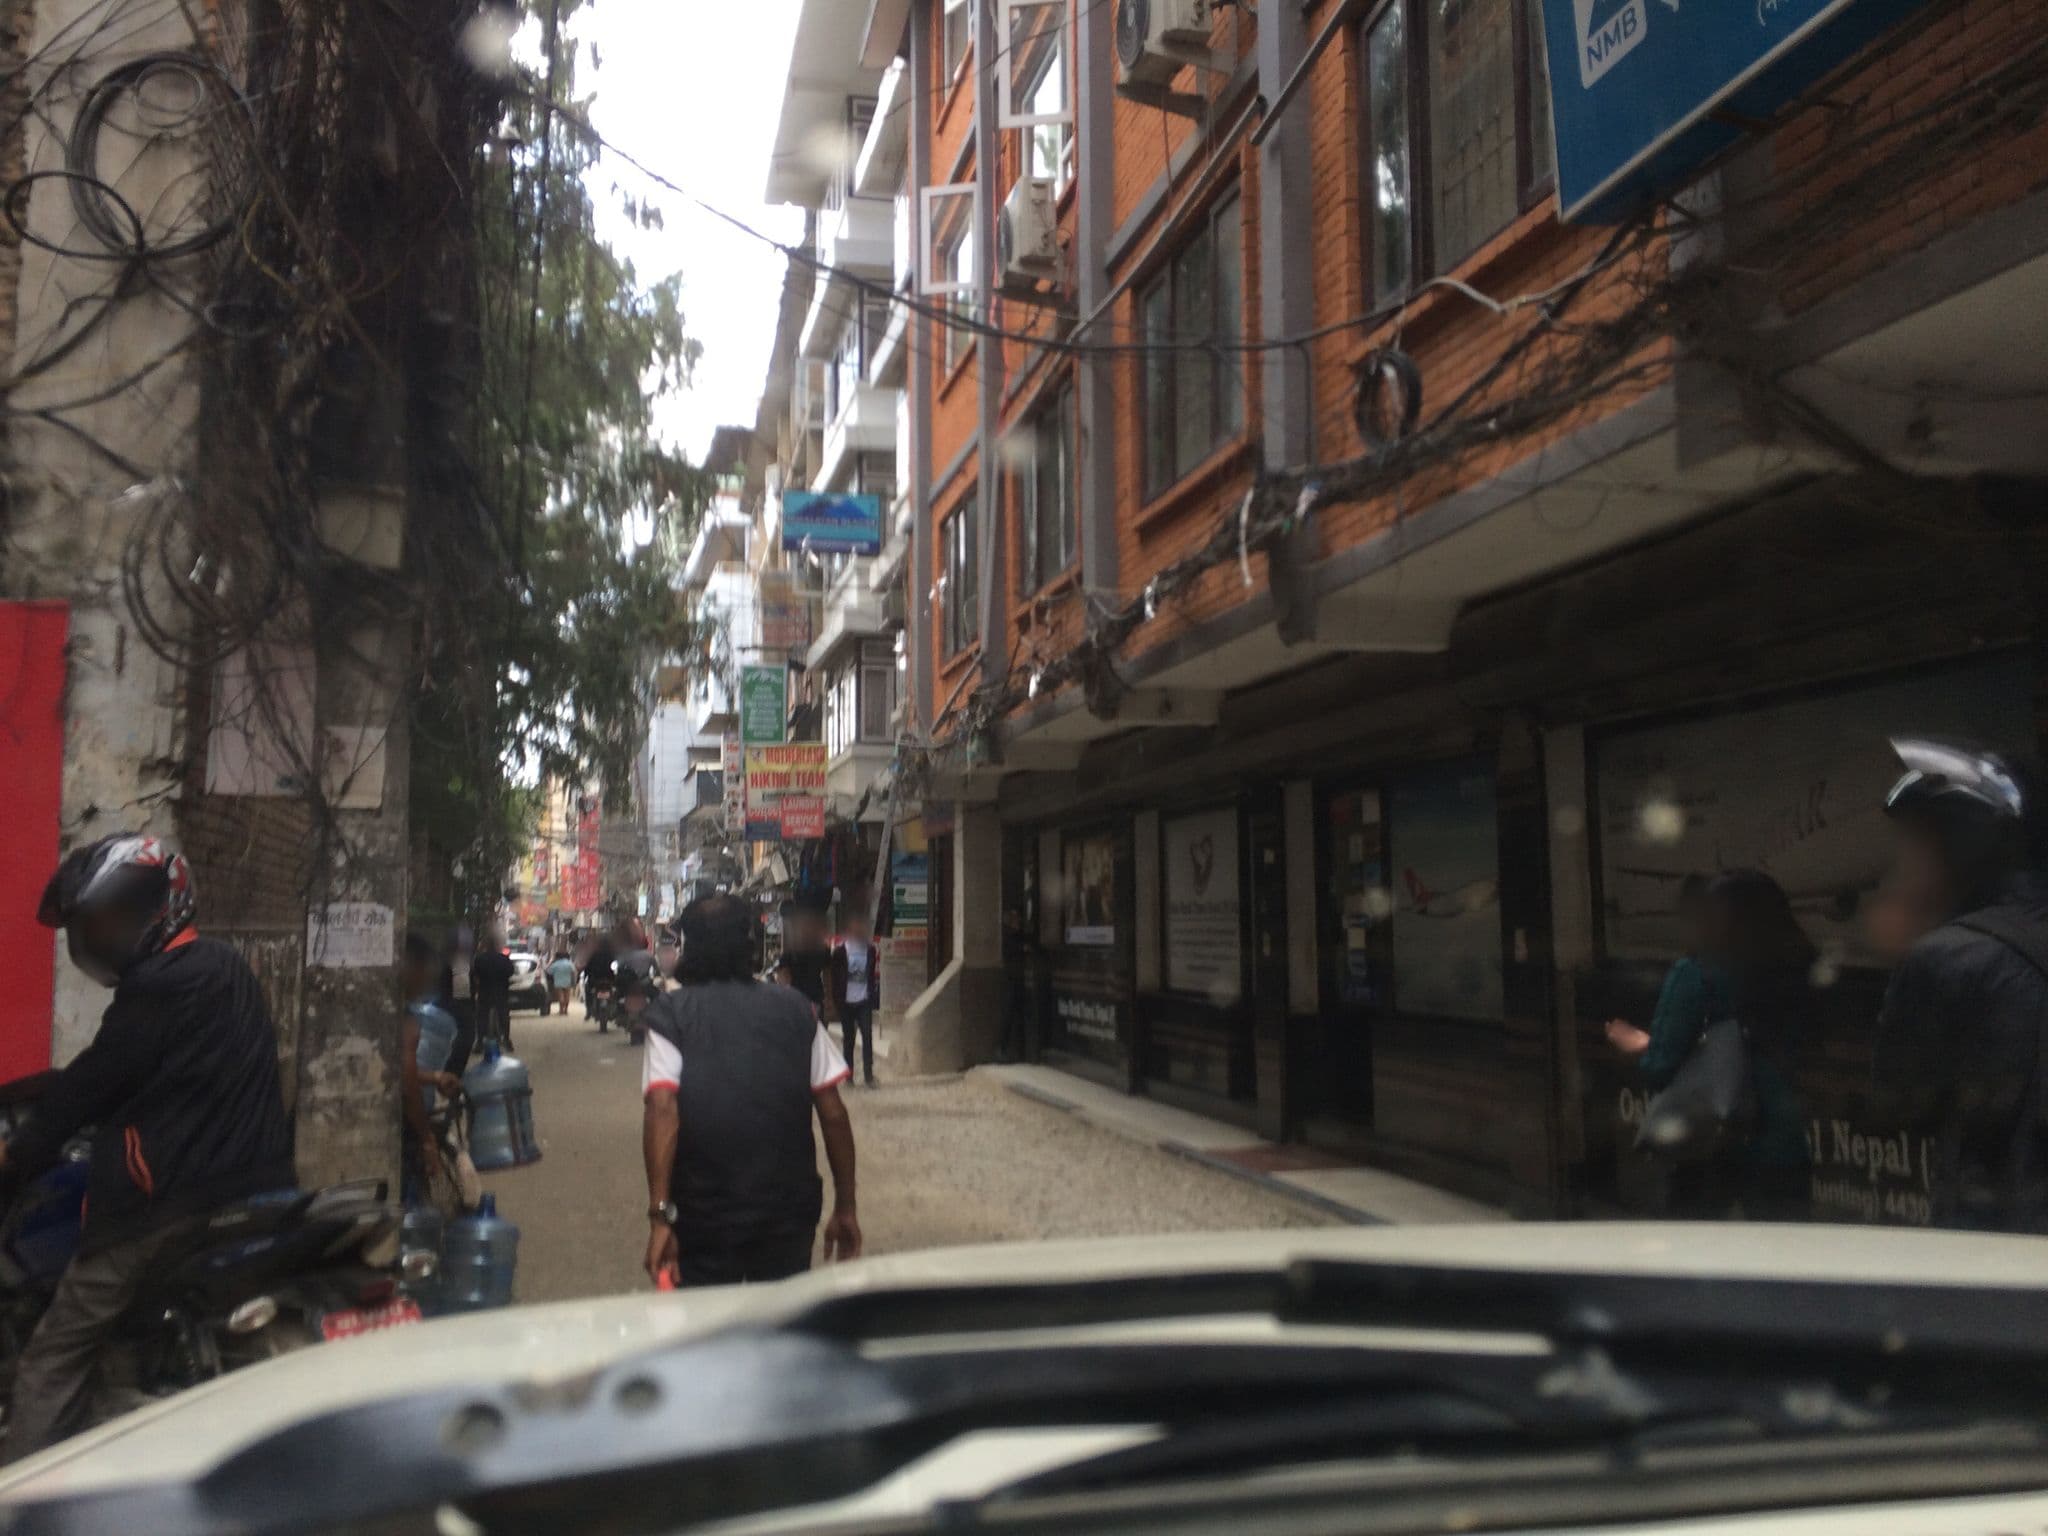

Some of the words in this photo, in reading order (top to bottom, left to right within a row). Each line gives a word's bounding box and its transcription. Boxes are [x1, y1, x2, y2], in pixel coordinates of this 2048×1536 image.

[1586, 7, 1638, 72] NMB
[796, 770, 826, 788] TEAM
[784, 815, 820, 826] SERVICE
[1832, 1120, 1912, 1182] Nepal
